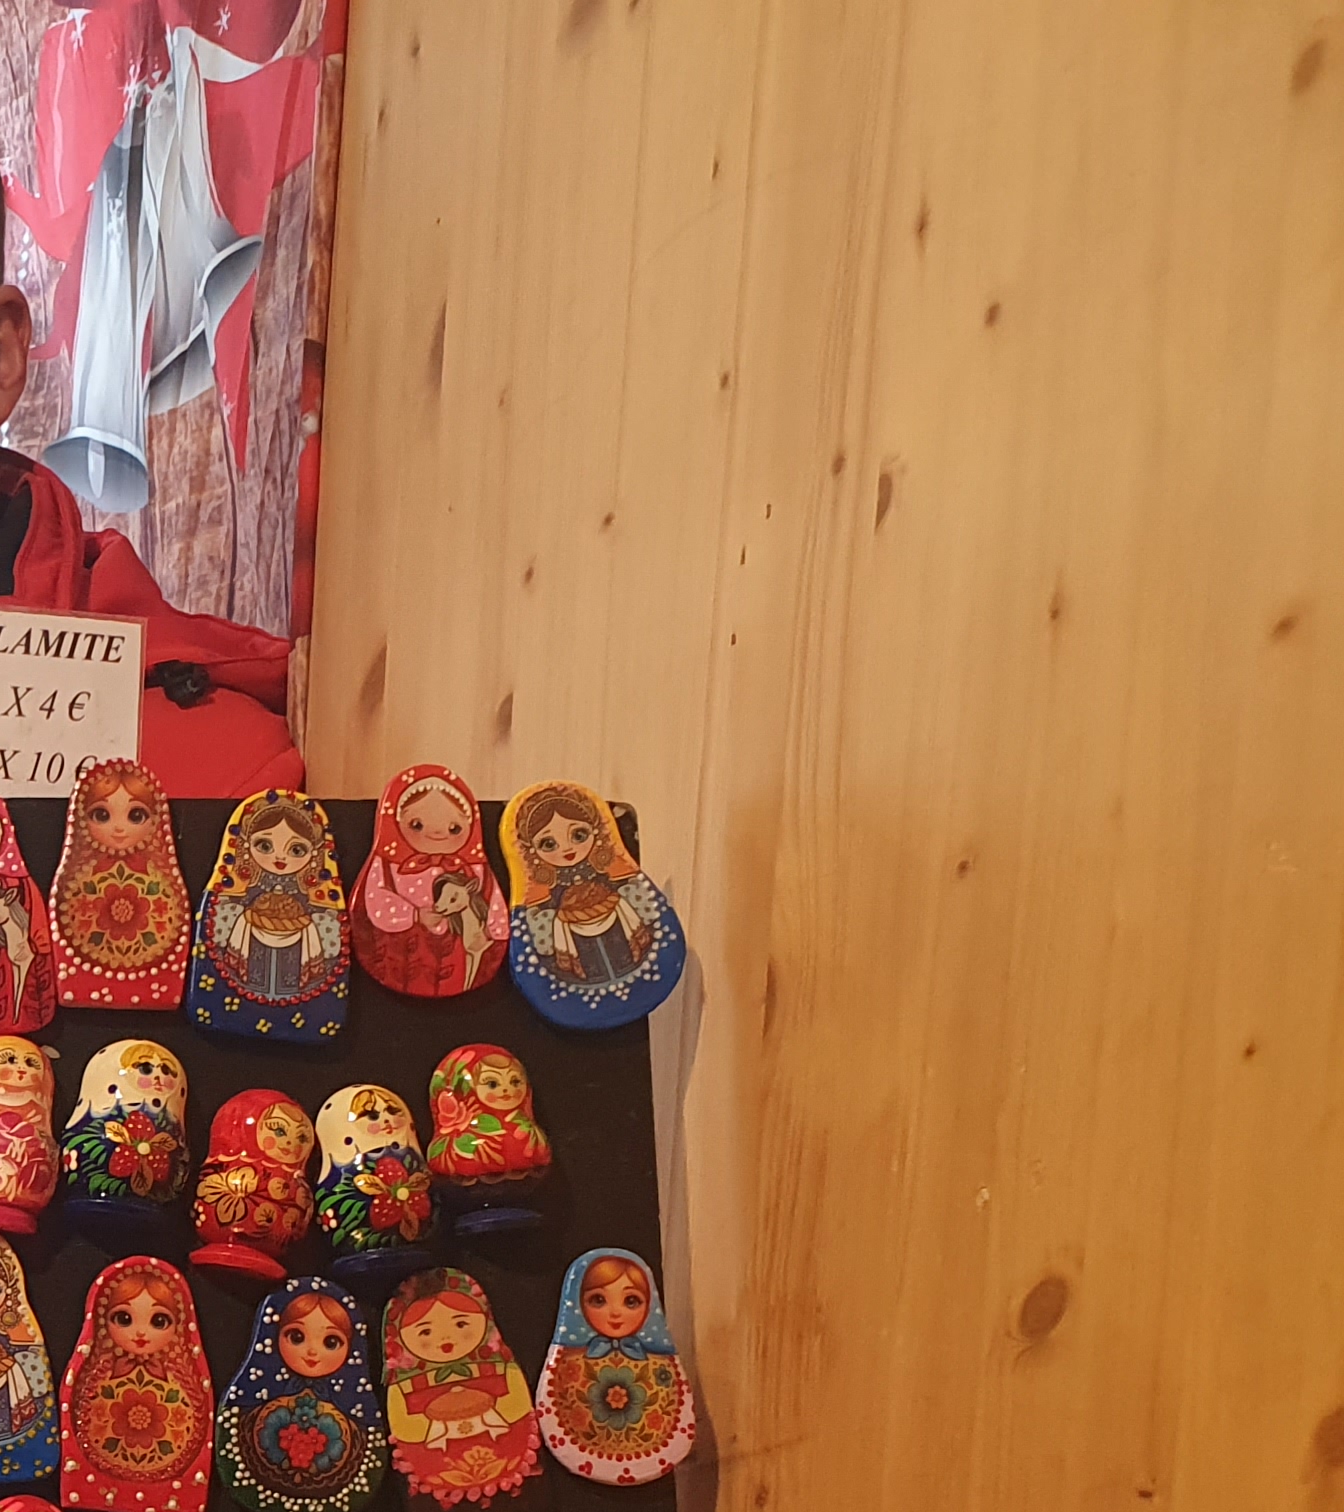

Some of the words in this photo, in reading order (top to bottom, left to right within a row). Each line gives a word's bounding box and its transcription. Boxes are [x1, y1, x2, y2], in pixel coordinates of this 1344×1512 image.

[0, 686, 33, 718] X
[39, 690, 59, 720] 4
[68, 691, 92, 722] €
[26, 751, 65, 785] 10
